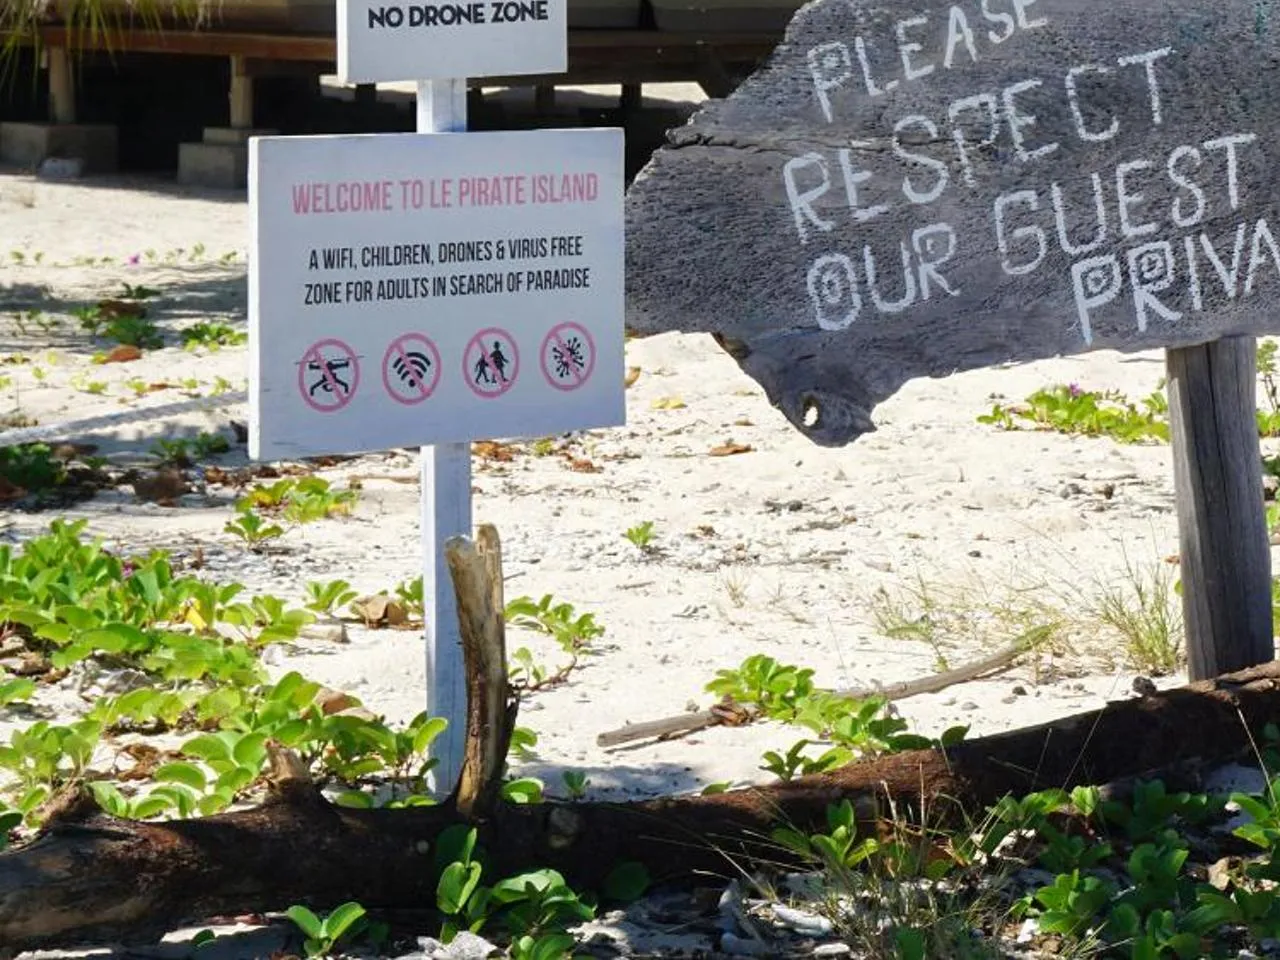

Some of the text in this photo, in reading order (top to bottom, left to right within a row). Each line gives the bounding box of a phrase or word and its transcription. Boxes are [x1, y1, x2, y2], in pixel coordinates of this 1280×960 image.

[367, 0, 549, 30] NO DRONE ZONE
[783, 46, 1176, 245] RESPECT
[292, 172, 599, 215] WELCOME TO LE PIRATE ISLAND
[309, 235, 584, 271] A WIFI, CHILDREN, DRONES & VIRUS FREE
[806, 133, 1258, 332] OUR GUEST
[304, 267, 591, 306] ZONE FOR ADULTS IN SEARCH OF PARADISE
